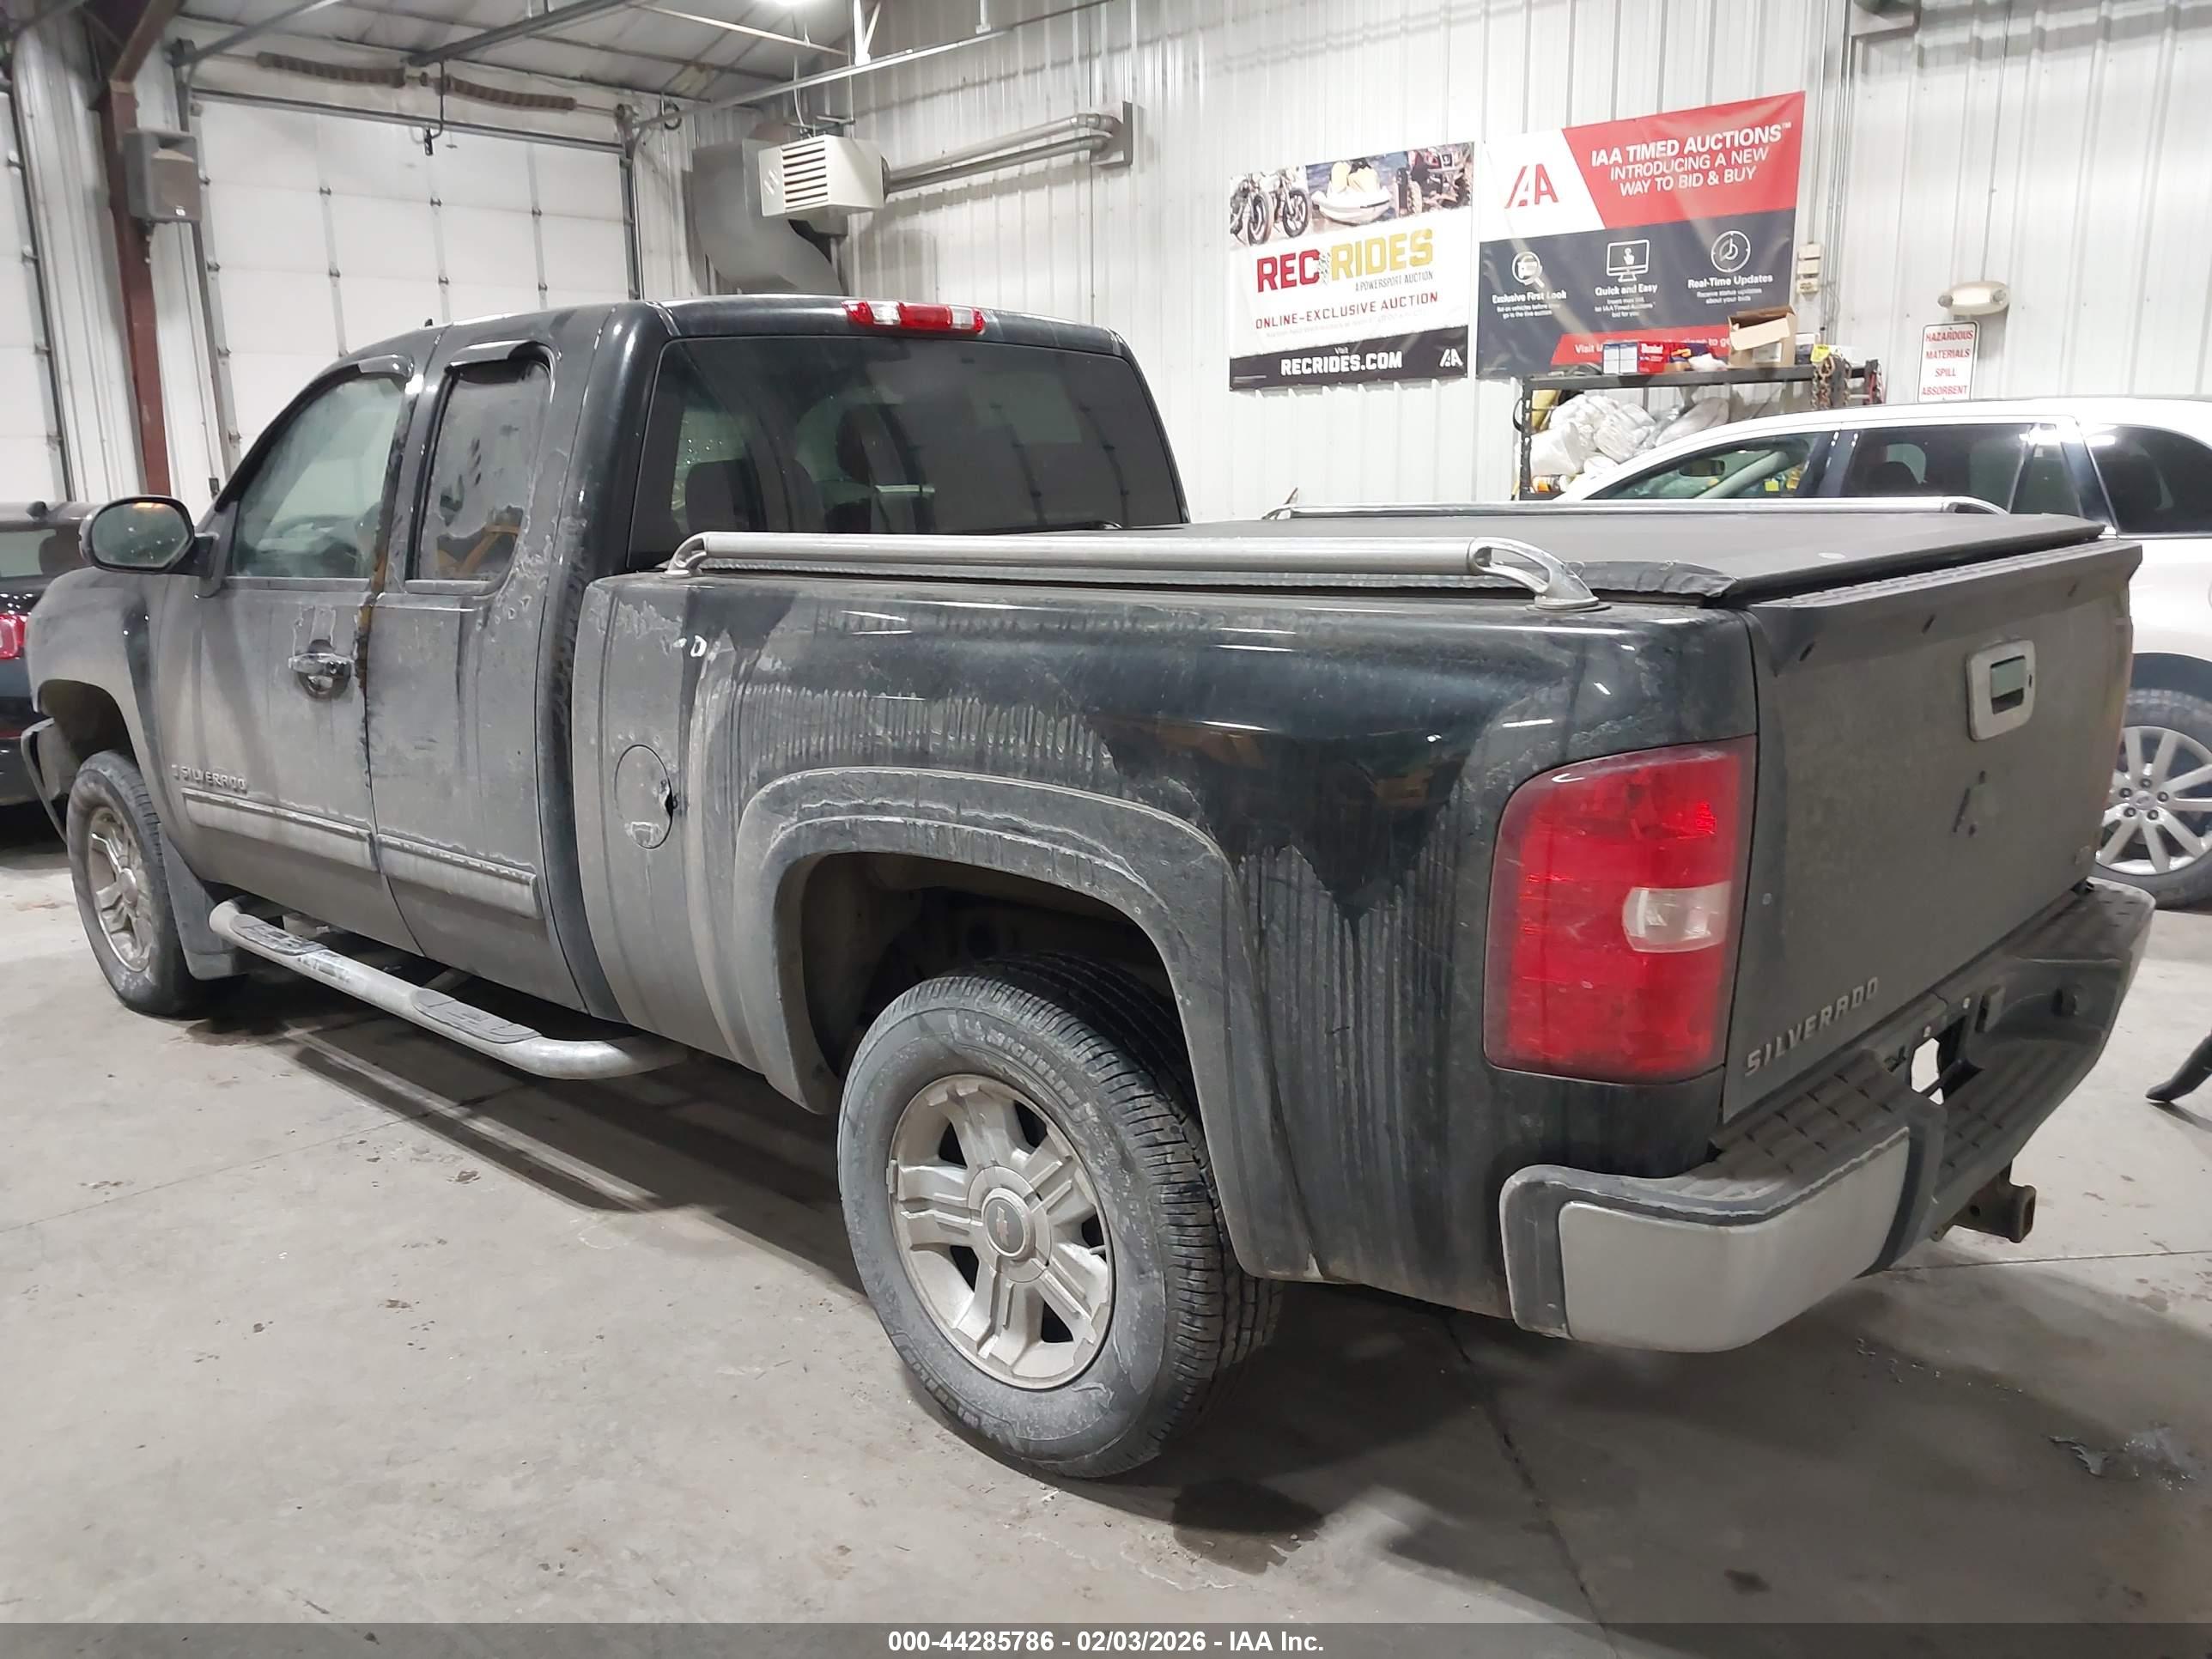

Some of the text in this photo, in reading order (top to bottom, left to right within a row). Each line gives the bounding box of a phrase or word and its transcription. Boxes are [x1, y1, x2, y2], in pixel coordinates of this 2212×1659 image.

[1591, 147, 1623, 167] IAA
[1626, 139, 1680, 163] TIMED
[1611, 146, 1770, 181] INTRODUCING A NEW
[1620, 165, 1757, 197] WAY TO BID & BUY
[1257, 228, 1434, 293] REC RIDES
[1404, 270, 1433, 284] AUCTION
[1687, 274, 1773, 289] Real-Time Updates
[1492, 289, 1567, 304] Exclusive First Look
[1595, 283, 1658, 296] Quick and Easy
[1255, 301, 1376, 330] ONLINE-EXCLUSIVE
[1380, 291, 1438, 311] AUCTION
[1708, 337, 1718, 346] to
[1925, 330, 1973, 342] HAZARDOUS
[1925, 349, 1971, 359] MATERIALS
[1280, 350, 1403, 376] RECRIDES.COM
[1935, 368, 1957, 378] SPILL
[1922, 385, 1968, 396] ABSORBENT
[179, 765, 247, 793] SILVERADO
[1744, 976, 1878, 1077] SILVERADO
